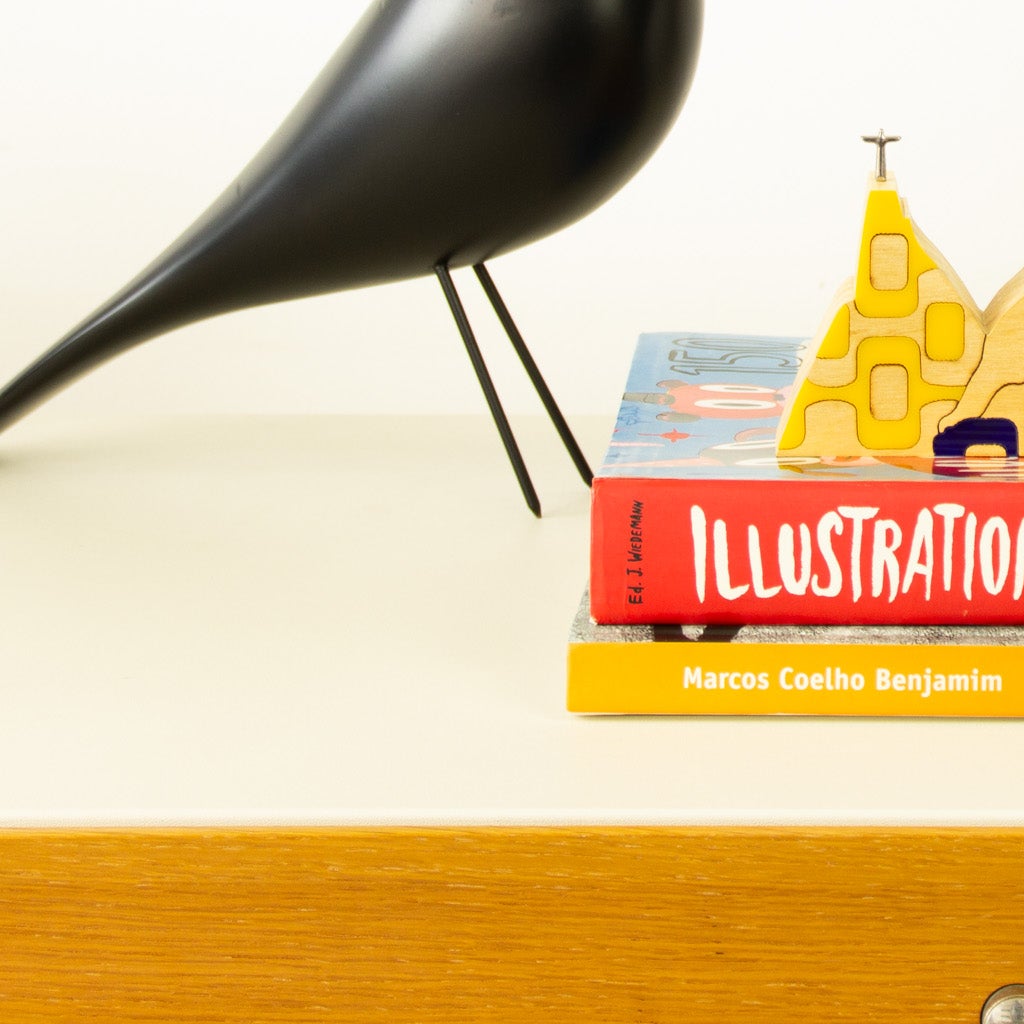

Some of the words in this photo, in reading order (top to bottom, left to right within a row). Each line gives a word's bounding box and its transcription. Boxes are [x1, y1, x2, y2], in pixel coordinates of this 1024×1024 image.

[668, 338, 807, 376] 150
[627, 499, 644, 562] WIEDEMANN
[626, 567, 643, 577] J.
[628, 582, 643, 604] Ed.
[682, 667, 769, 691] Marcos
[779, 667, 865, 691] Coelho
[875, 667, 1003, 697] Benjamim
